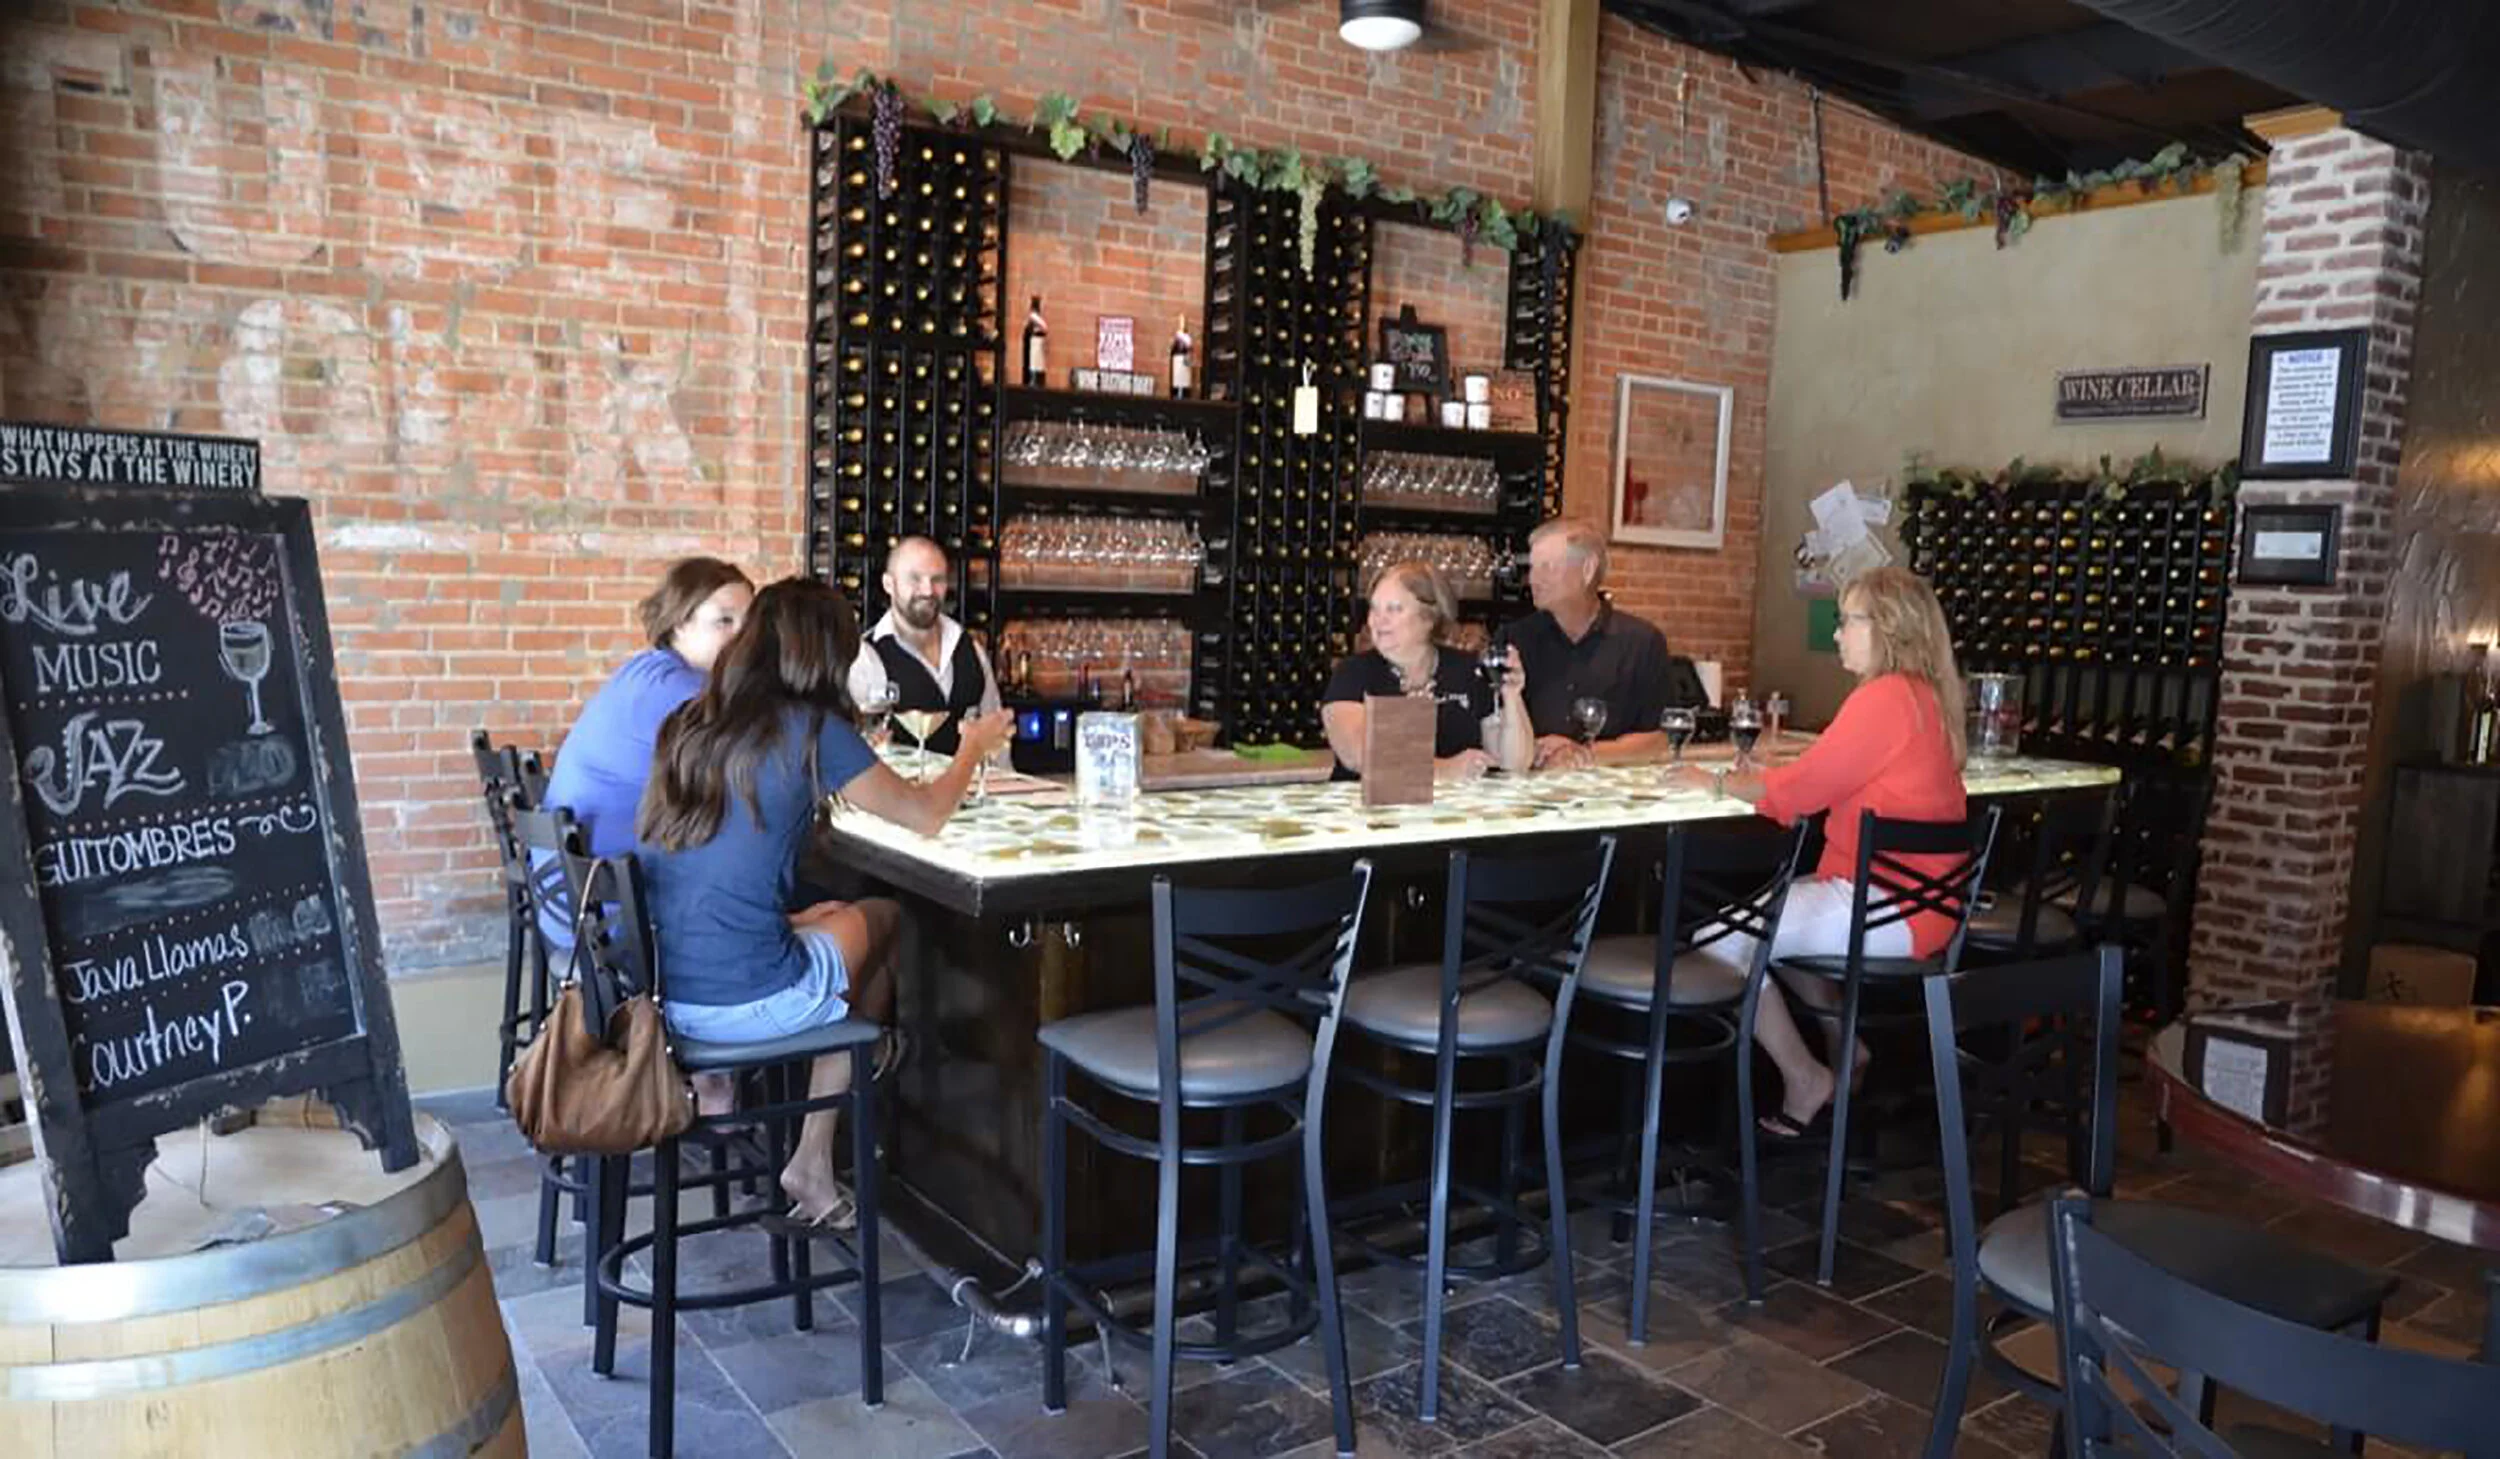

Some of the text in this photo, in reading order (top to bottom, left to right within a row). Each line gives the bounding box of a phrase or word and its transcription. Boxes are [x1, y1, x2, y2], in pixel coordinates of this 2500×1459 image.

[2063, 373, 2196, 401] WINE CELLAR
[0, 427, 257, 466] WHAT HAPPENS AT THE WINERY
[2, 448, 257, 488] STAYS AT THE WINERY
[0, 552, 154, 635] Live
[32, 639, 162, 693] MUSIC
[34, 817, 236, 888] GUITOMBRES
[62, 957, 145, 1004] Java
[143, 923, 249, 981] Llamas
[222, 979, 251, 1036] P.
